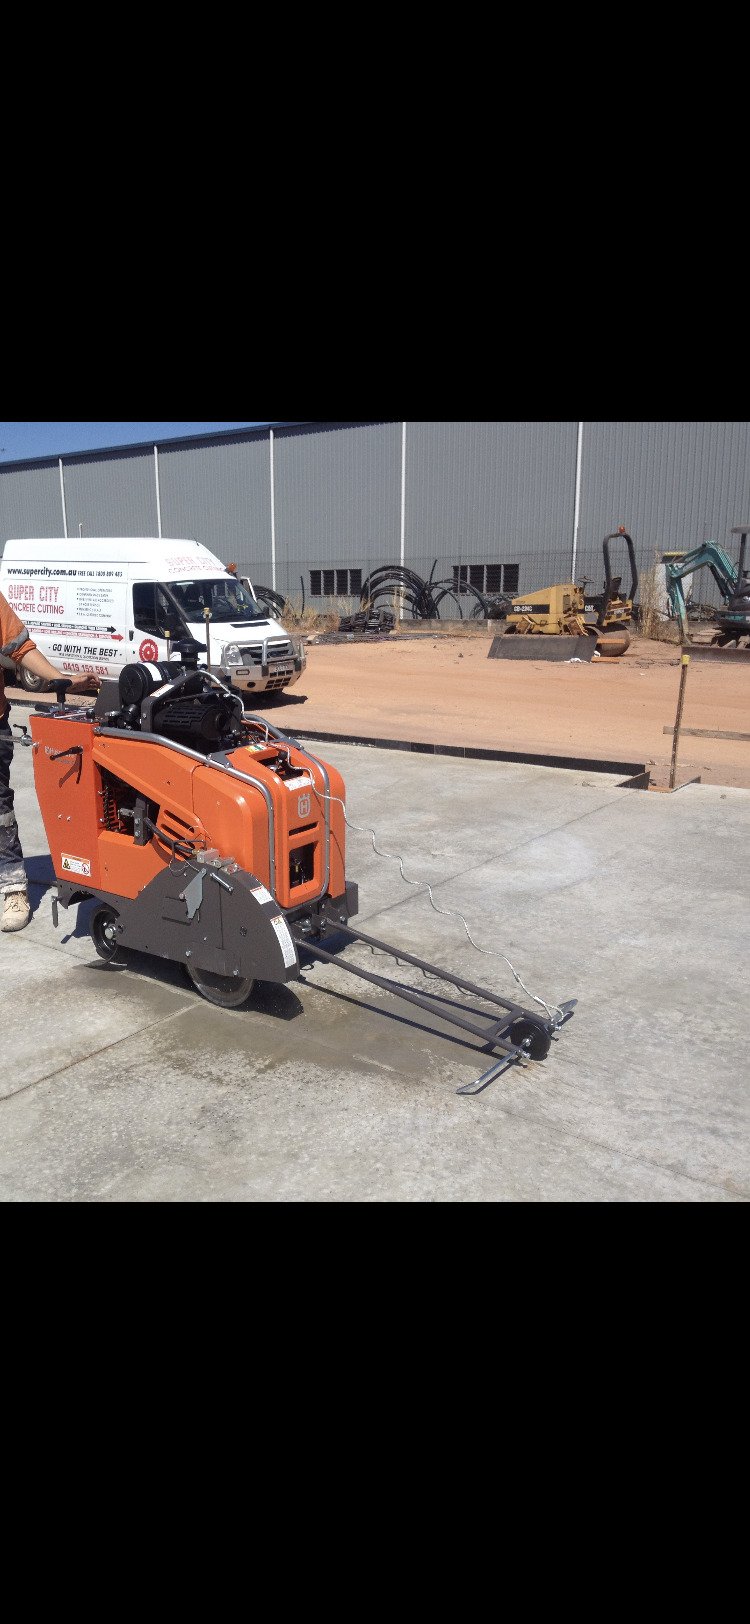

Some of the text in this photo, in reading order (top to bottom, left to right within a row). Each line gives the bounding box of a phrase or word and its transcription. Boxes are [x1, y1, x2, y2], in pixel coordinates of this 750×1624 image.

[7, 567, 77, 577] www.supercity.com.au
[8, 584, 60, 603] SUPER CITY
[9, 602, 36, 613] ONCRETE
[37, 604, 65, 615] CUTTING
[52, 643, 62, 652] GO
[64, 645, 81, 654] WITH
[83, 647, 97, 656] THE
[98, 648, 119, 657] BEST
[62, 662, 109, 675] 0419 153 581
